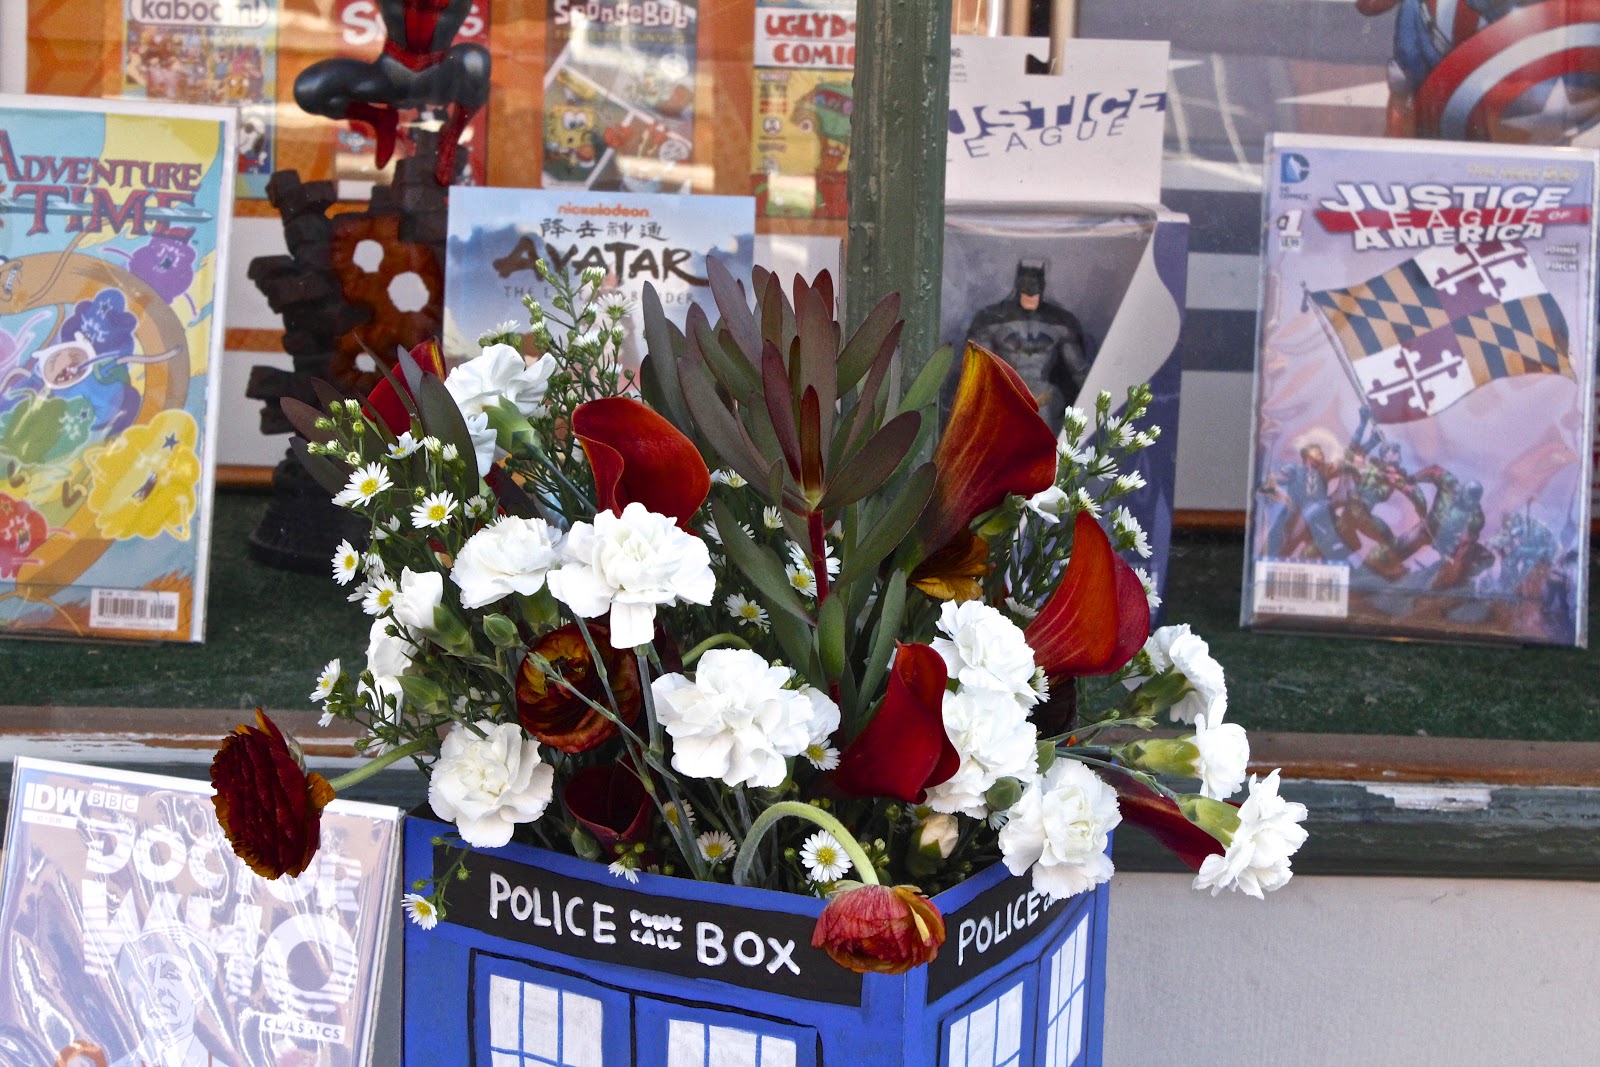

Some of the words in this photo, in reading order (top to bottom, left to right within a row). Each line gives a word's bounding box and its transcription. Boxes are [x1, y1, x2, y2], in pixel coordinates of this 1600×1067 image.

[765, 13, 857, 38] UGLYD
[947, 88, 1167, 140] USTICE
[947, 116, 1126, 162] EAGUE
[13, 183, 196, 240] TIME
[557, 203, 649, 217] nickelodeon
[1320, 183, 1571, 212] JUSTICE
[1350, 206, 1544, 232] LEAGUE
[1354, 223, 1544, 250] AMERICA
[493, 236, 711, 287] AVATAR
[23, 782, 87, 816] IDW
[88, 789, 139, 813] BBC
[489, 871, 617, 945] POLICE
[958, 890, 1041, 966] POLICE
[696, 921, 801, 976] BOX
